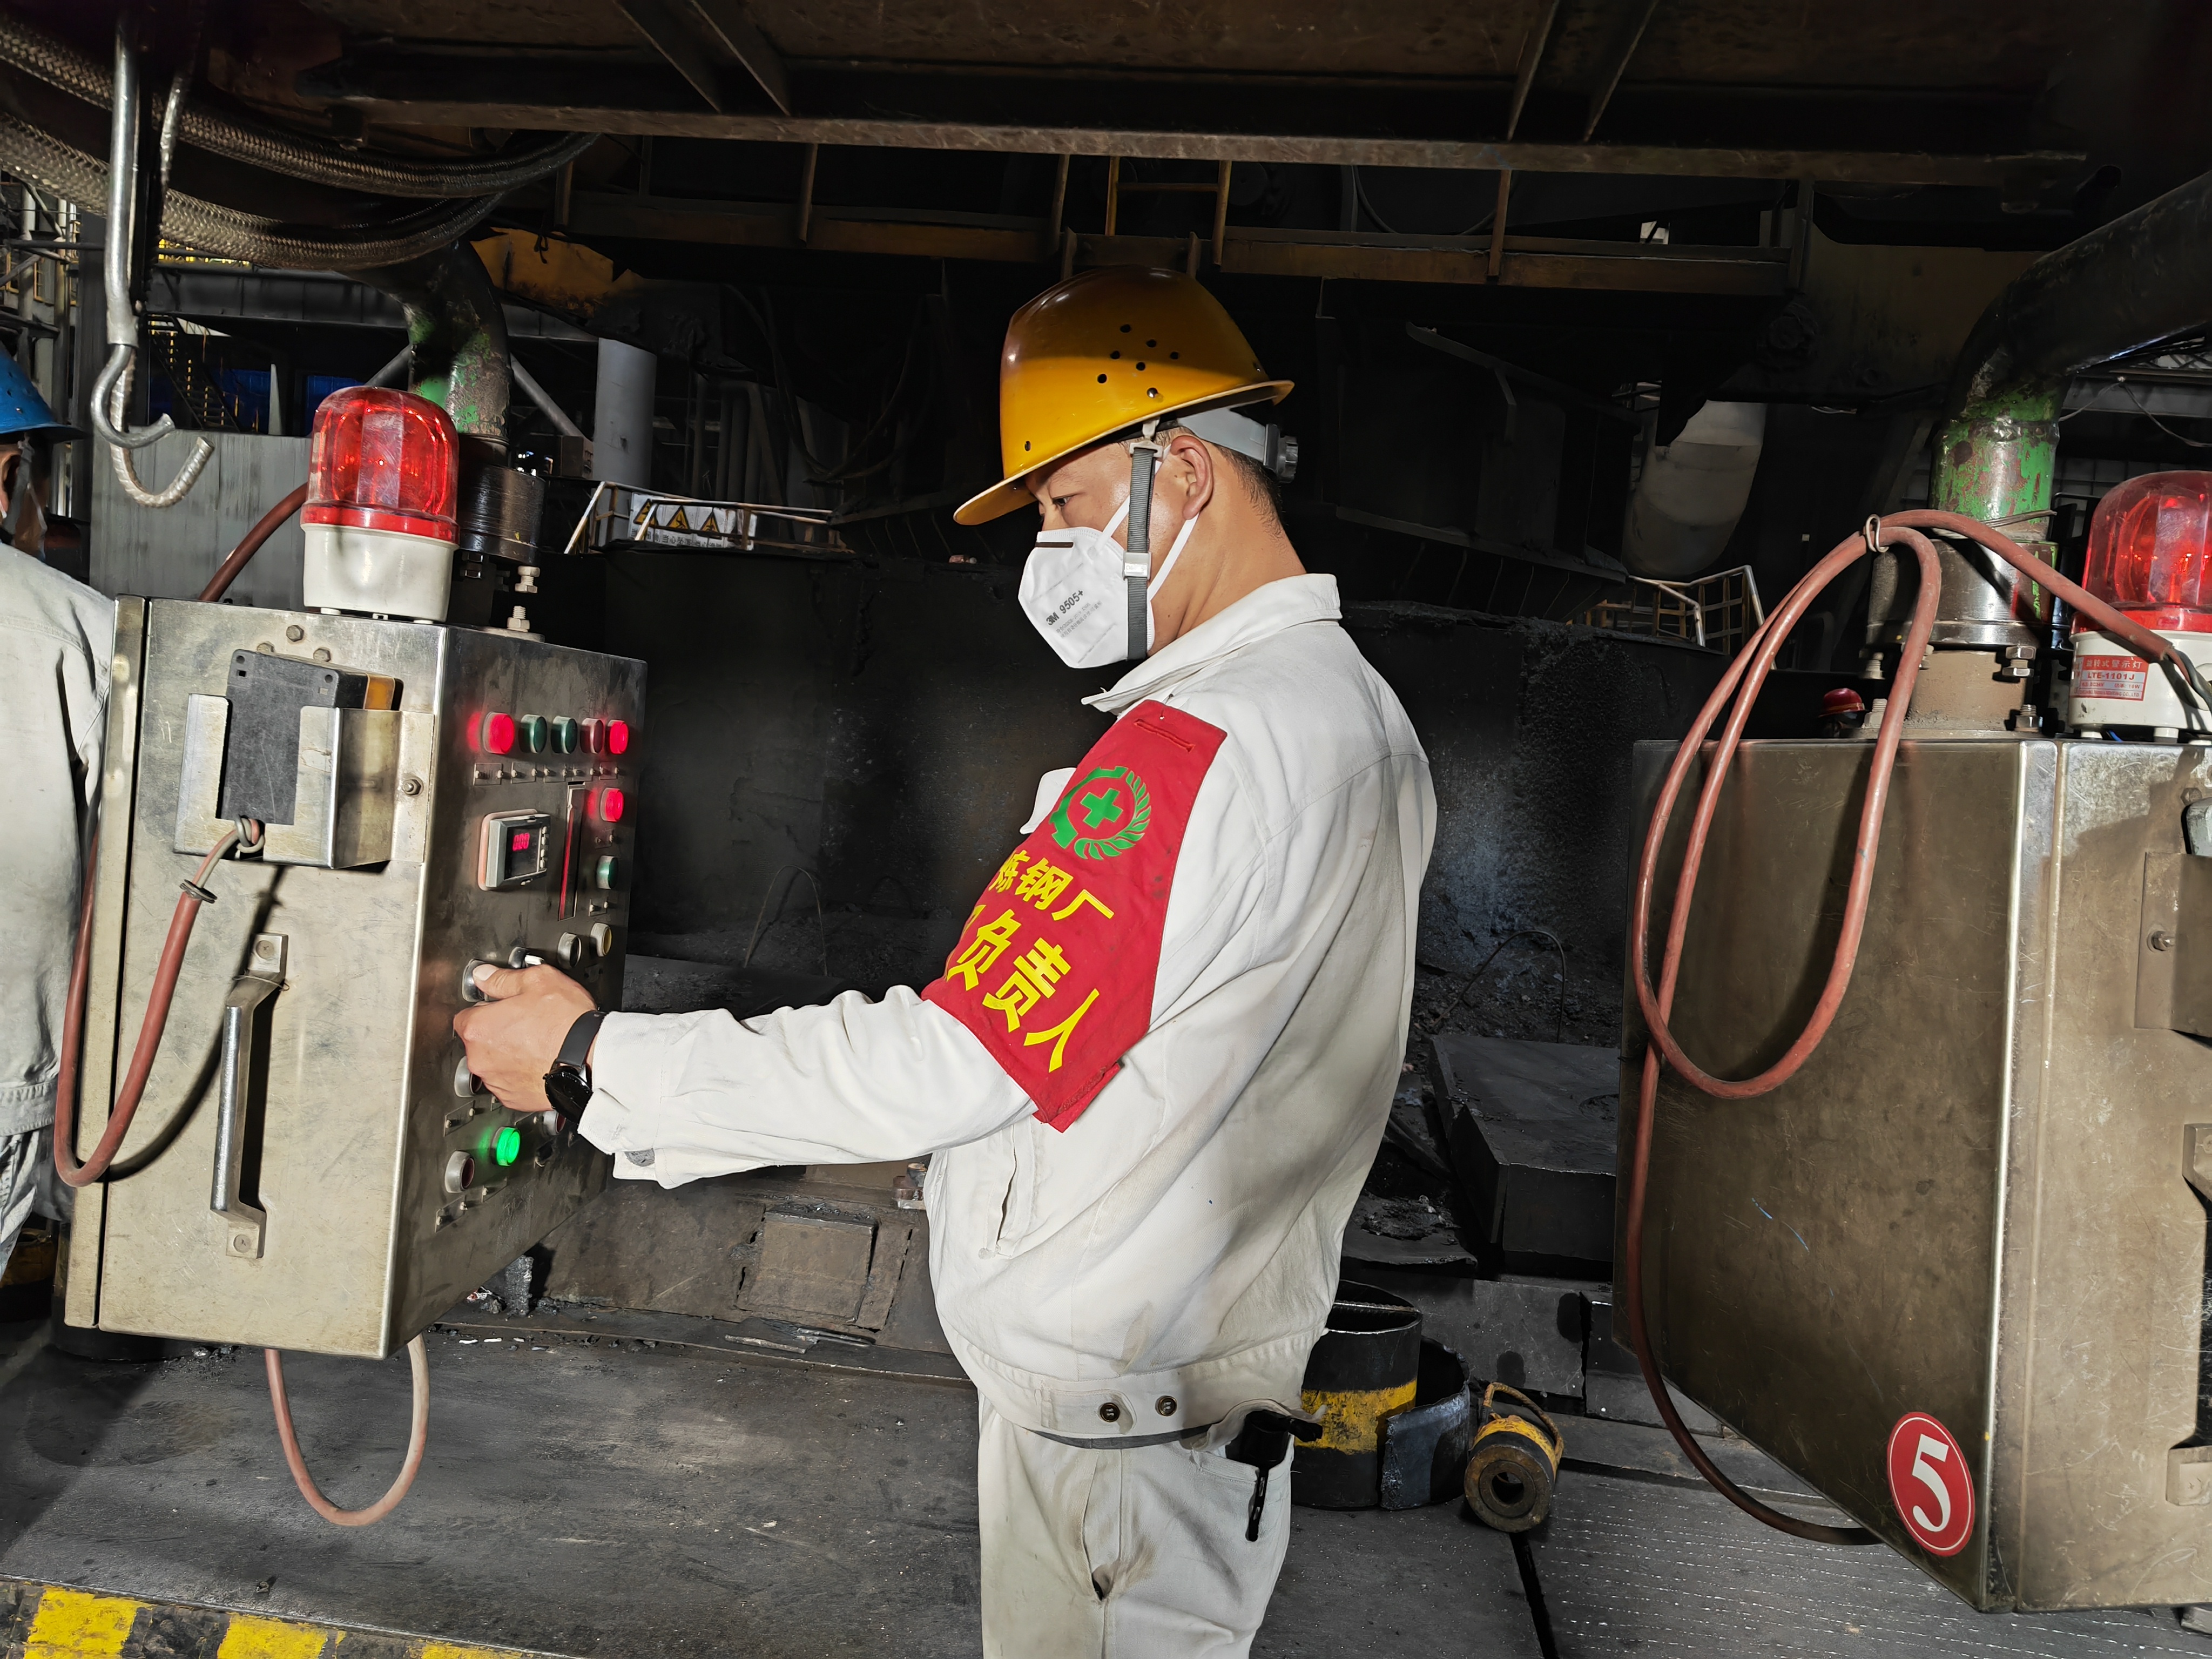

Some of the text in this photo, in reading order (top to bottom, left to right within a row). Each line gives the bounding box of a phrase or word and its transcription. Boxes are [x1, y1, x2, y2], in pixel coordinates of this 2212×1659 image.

[1046, 611, 1060, 625] 3M
[1059, 590, 1083, 614] 9505+
[2087, 672, 2135, 680] LTE-1101J
[946, 906, 1100, 1073] 负责人
[1912, 1433, 1951, 1532] 5
